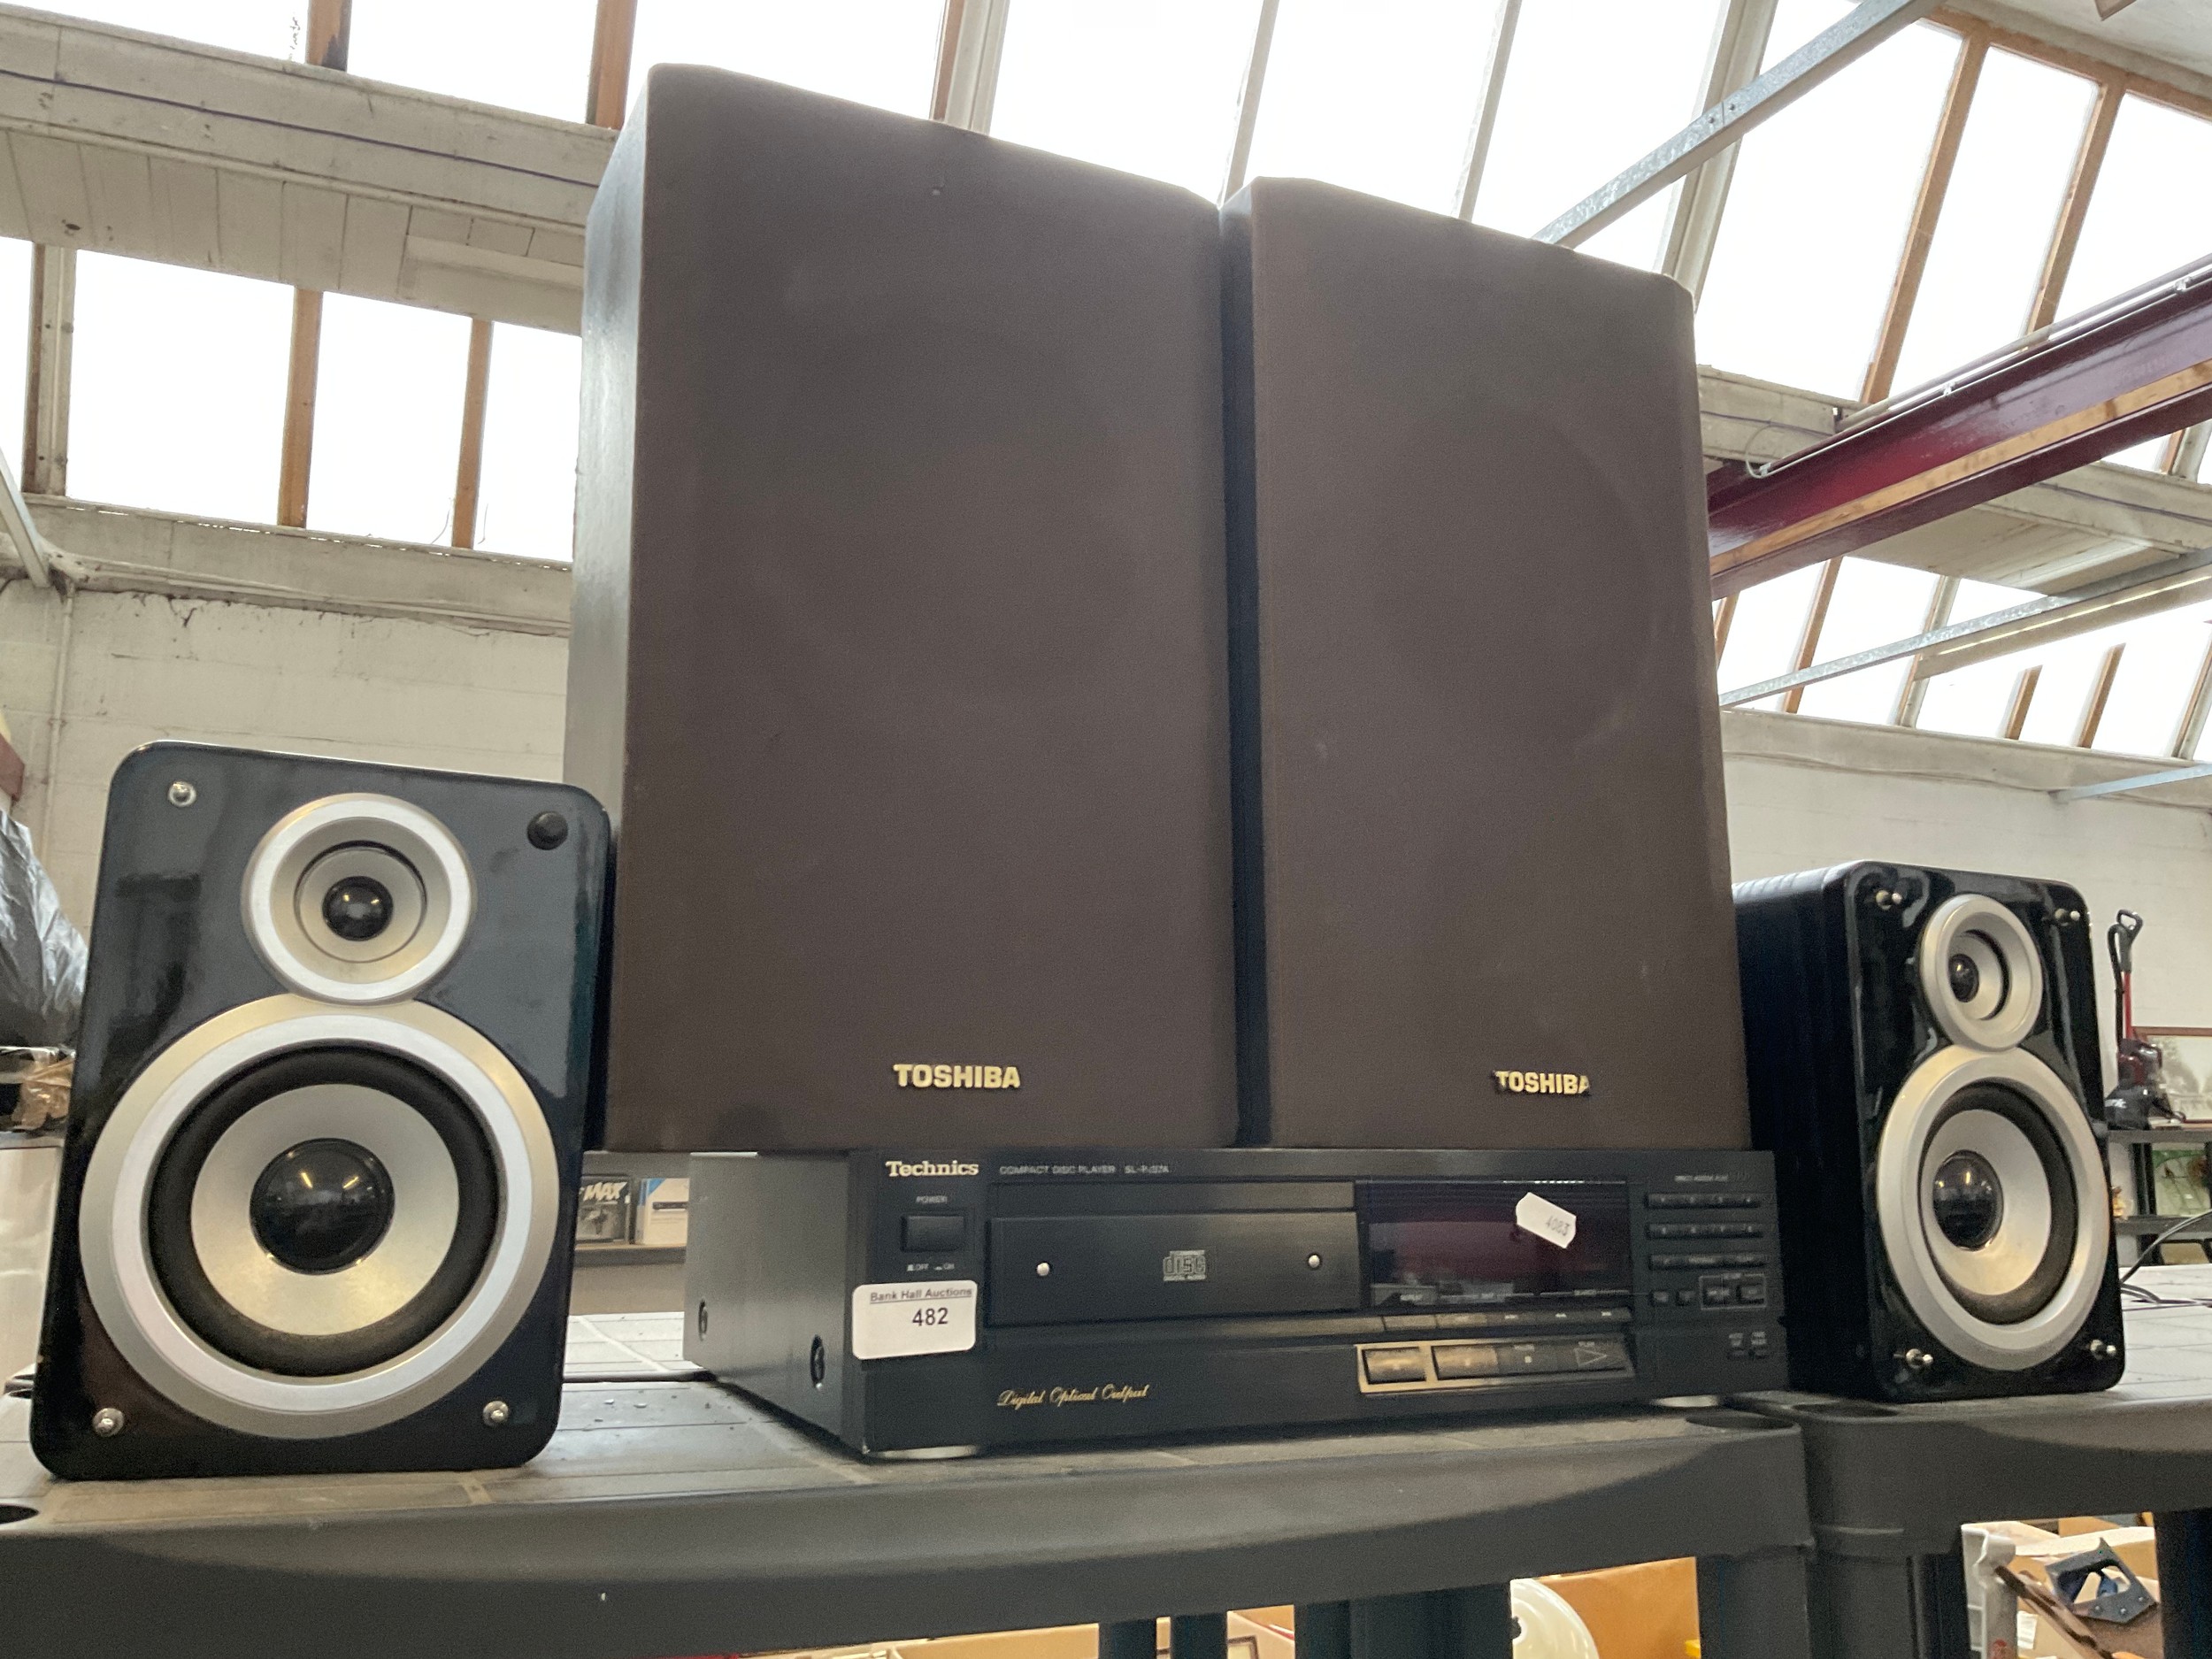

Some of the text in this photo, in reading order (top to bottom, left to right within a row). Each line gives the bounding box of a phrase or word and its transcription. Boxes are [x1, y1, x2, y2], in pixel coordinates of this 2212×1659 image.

[893, 1064, 1021, 1088] TOSHIBA
[1494, 1071, 1590, 1094] TOSHIBA
[885, 1160, 979, 1177] Technics
[999, 1165, 1048, 1175] COMPACT
[1078, 1164, 1117, 1174] PLAYER
[870, 1287, 972, 1302] Bank Hall Auctions
[912, 1307, 949, 1326] 482
[997, 1383, 1150, 1410] Digital Optical Output
